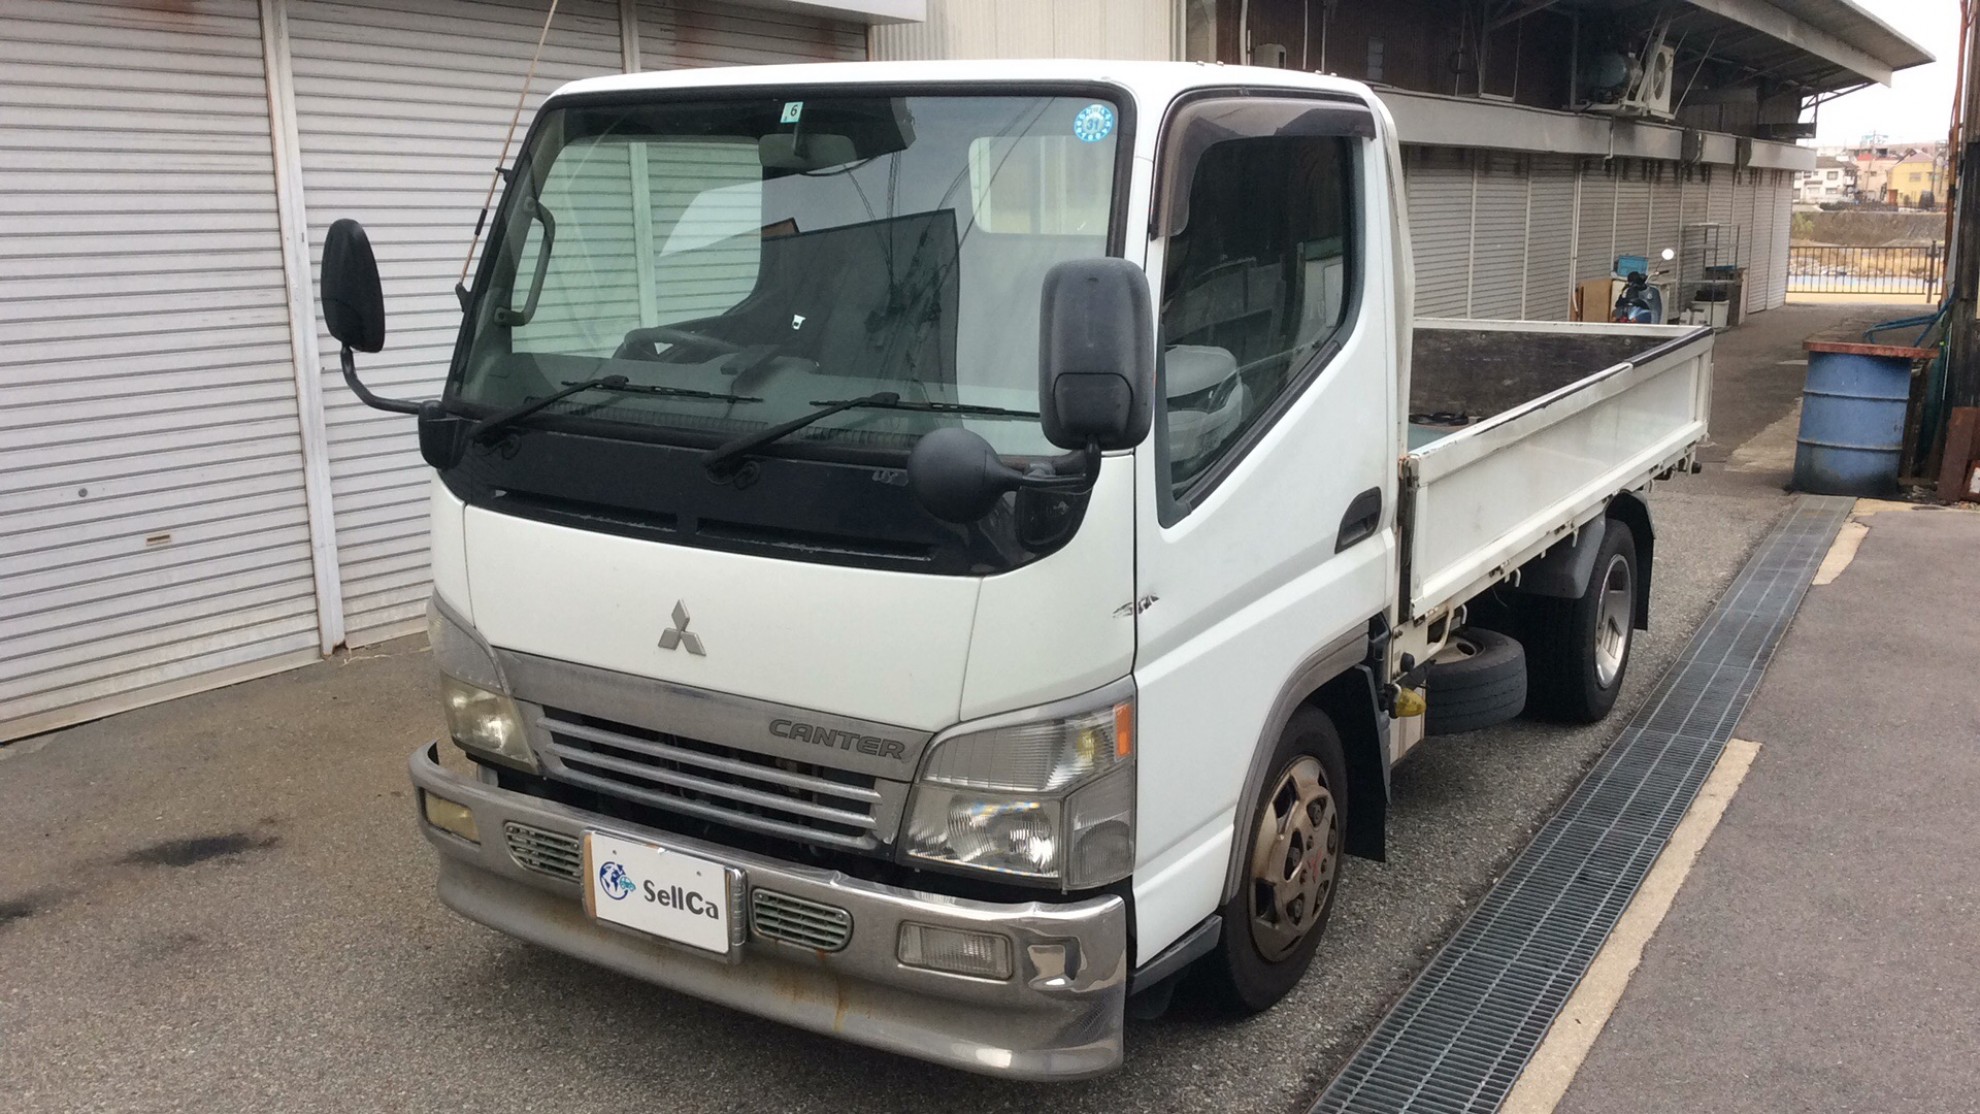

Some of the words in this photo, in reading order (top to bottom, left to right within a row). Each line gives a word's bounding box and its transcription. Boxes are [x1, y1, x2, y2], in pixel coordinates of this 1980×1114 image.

[790, 104, 798, 117] 6
[768, 719, 906, 760] CANTER
[643, 879, 720, 920] SellCa
